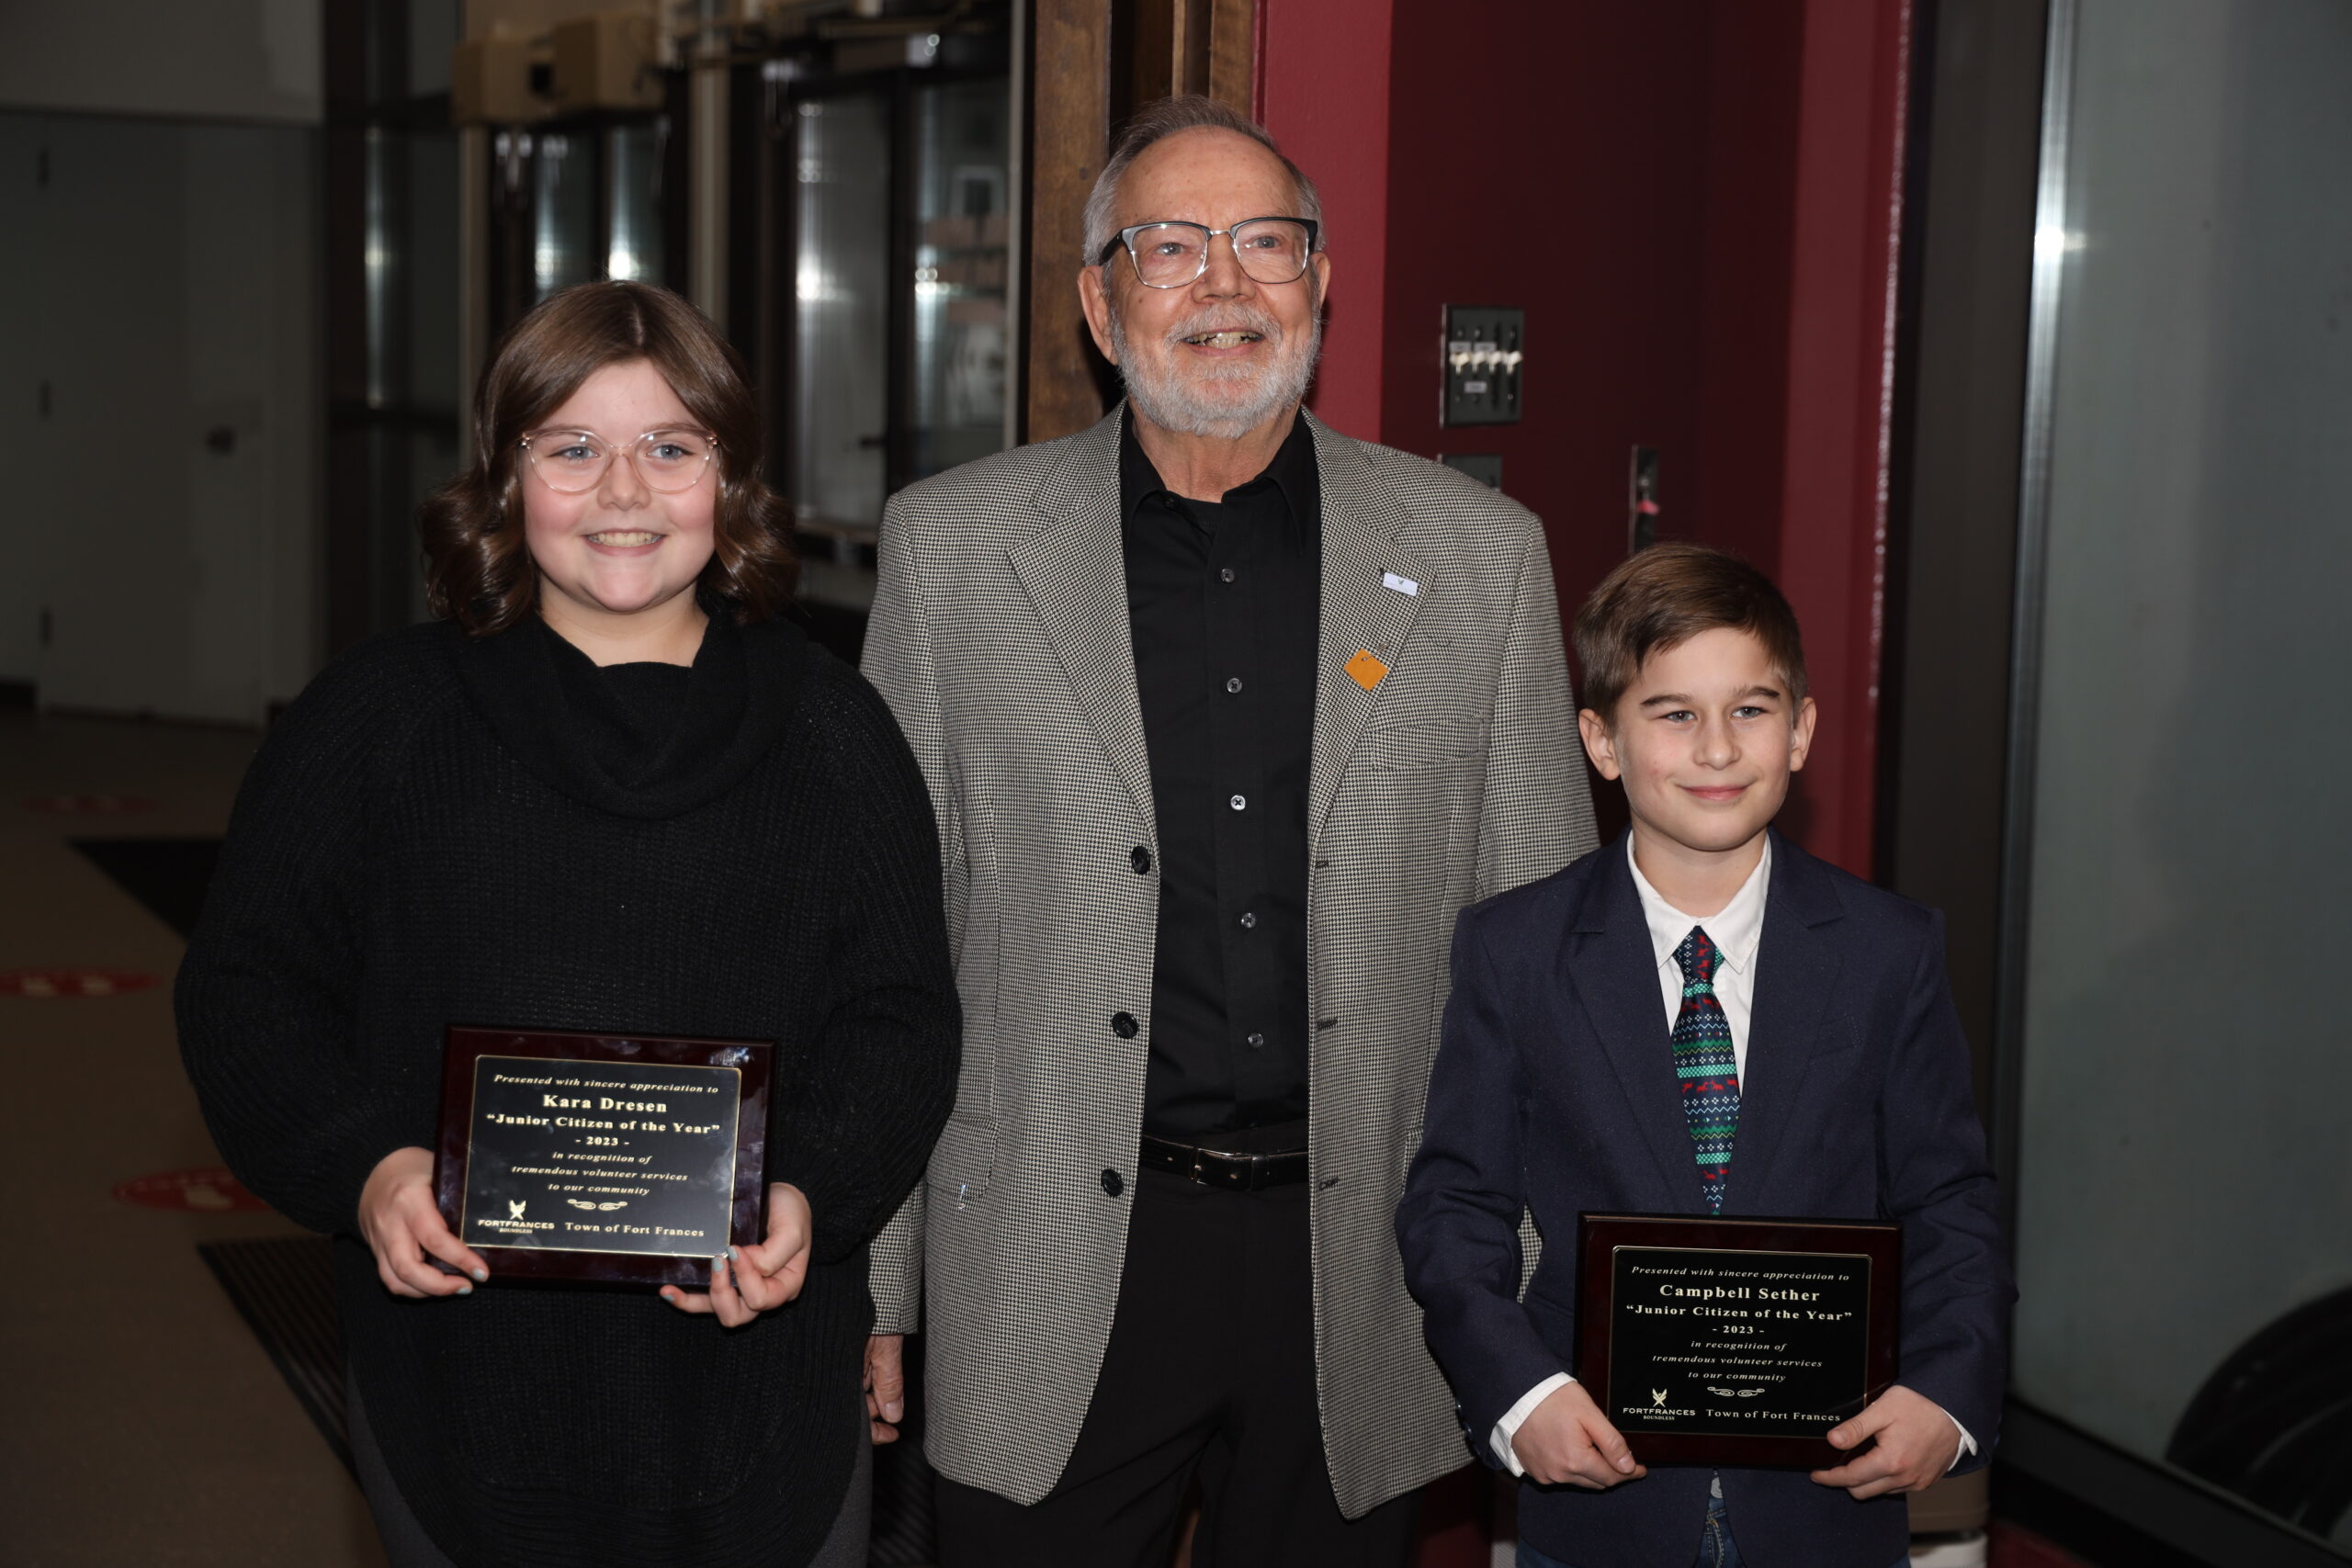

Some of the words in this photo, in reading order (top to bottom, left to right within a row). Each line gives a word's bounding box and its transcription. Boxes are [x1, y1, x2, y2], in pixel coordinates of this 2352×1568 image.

[494, 1074, 553, 1085] Presented
[556, 1077, 581, 1087] with
[584, 1079, 627, 1089] sincere
[630, 1083, 704, 1093] appreciation
[707, 1086, 719, 1094] to
[544, 1094, 592, 1110] Kara
[601, 1097, 667, 1113] Dresen
[556, 1116, 614, 1129] Citizen
[620, 1120, 638, 1131] of
[642, 1121, 666, 1132] the
[587, 1135, 619, 1146] 2023
[553, 1151, 564, 1159] in
[568, 1152, 634, 1164] recognition
[639, 1155, 652, 1165] of
[512, 1166, 579, 1176] tremendous
[583, 1168, 638, 1179] volunteer
[641, 1172, 688, 1181] services
[588, 1186, 650, 1197] community
[565, 1222, 600, 1233] Town
[605, 1224, 620, 1234] of
[624, 1224, 650, 1235] Fort
[655, 1226, 705, 1237] Frances
[1632, 1266, 1688, 1275] Presented
[1719, 1269, 1759, 1278] sincere
[1763, 1272, 1835, 1280] appreciation
[1660, 1284, 1750, 1301] Campbell
[1758, 1288, 1820, 1302] Sether
[1693, 1306, 1748, 1317] Citizen
[1755, 1309, 1771, 1318] of
[1777, 1309, 1800, 1319] the
[1724, 1325, 1754, 1335] 2023
[1706, 1342, 1770, 1350] recognition
[1774, 1343, 1788, 1352] of
[1653, 1355, 1716, 1363] tremendous
[1721, 1357, 1773, 1365] volunteer
[1726, 1373, 1786, 1382] community
[1706, 1408, 1739, 1418] Town
[1745, 1410, 1758, 1418] of
[1763, 1411, 1787, 1420] Fort
[1792, 1412, 1841, 1422] Frances
